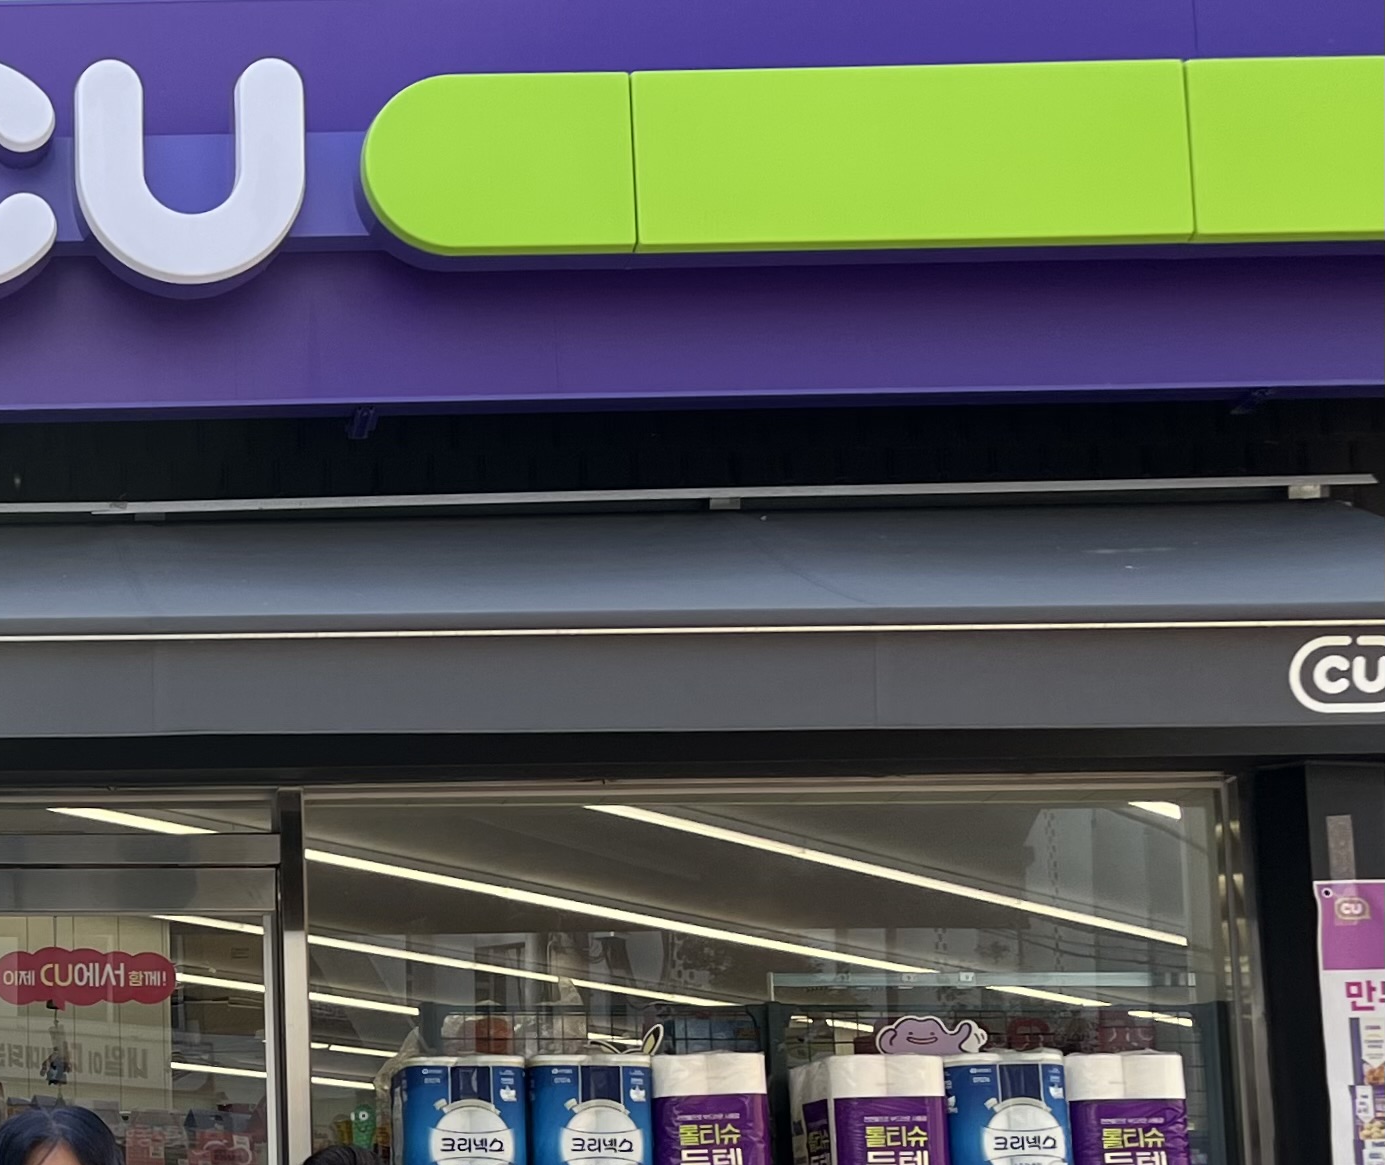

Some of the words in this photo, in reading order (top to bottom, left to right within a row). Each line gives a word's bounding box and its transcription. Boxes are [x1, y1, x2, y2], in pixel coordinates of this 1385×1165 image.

[1312, 654, 1385, 694] CU
[3, 970, 36, 987] 이제
[40, 962, 125, 988] CU에서
[128, 970, 167, 987] 함께!
[440, 1137, 505, 1153] 크리넥스
[571, 1137, 634, 1153] 크리넥스
[679, 1123, 742, 1146] 롤티슈
[865, 1125, 929, 1148] 롤티슈
[993, 1136, 1058, 1151] 크리넥스
[1102, 1127, 1166, 1149] 롤티슈
